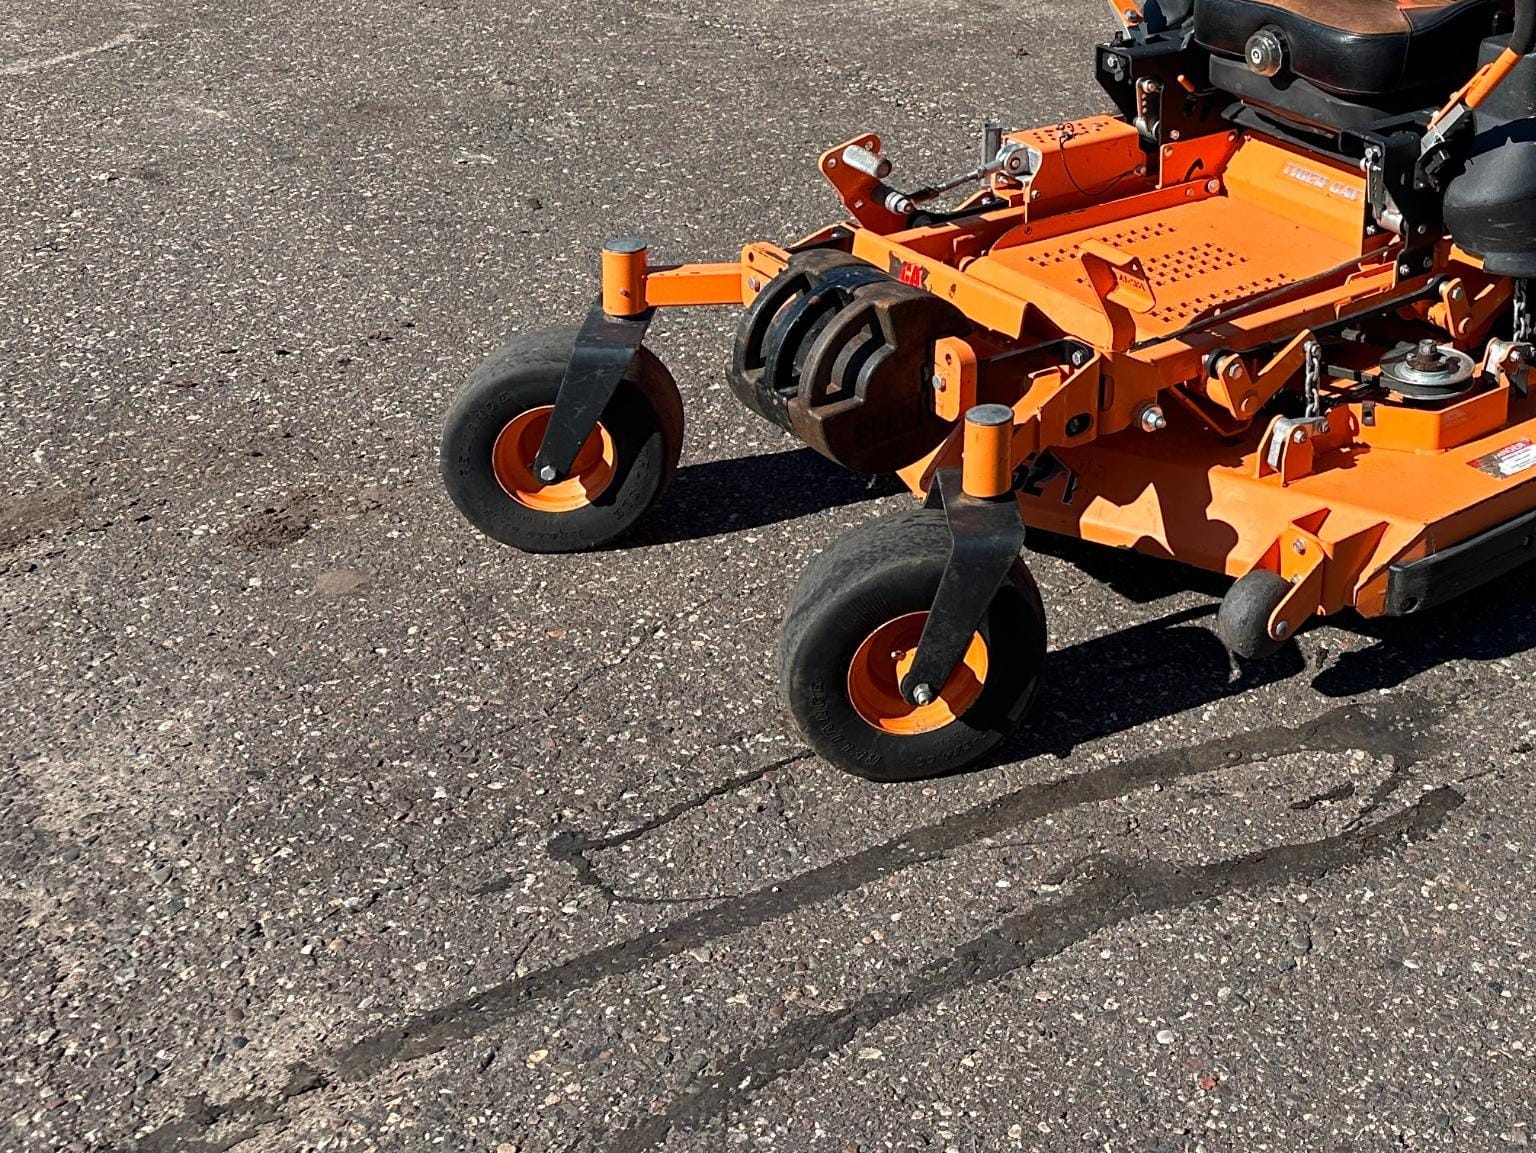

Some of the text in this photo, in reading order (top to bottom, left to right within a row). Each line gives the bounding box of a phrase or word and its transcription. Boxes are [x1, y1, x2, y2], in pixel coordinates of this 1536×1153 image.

[1283, 163, 1362, 202] TIGER CAT
[899, 260, 922, 288] CA
[810, 680, 882, 767] RELIANCE
